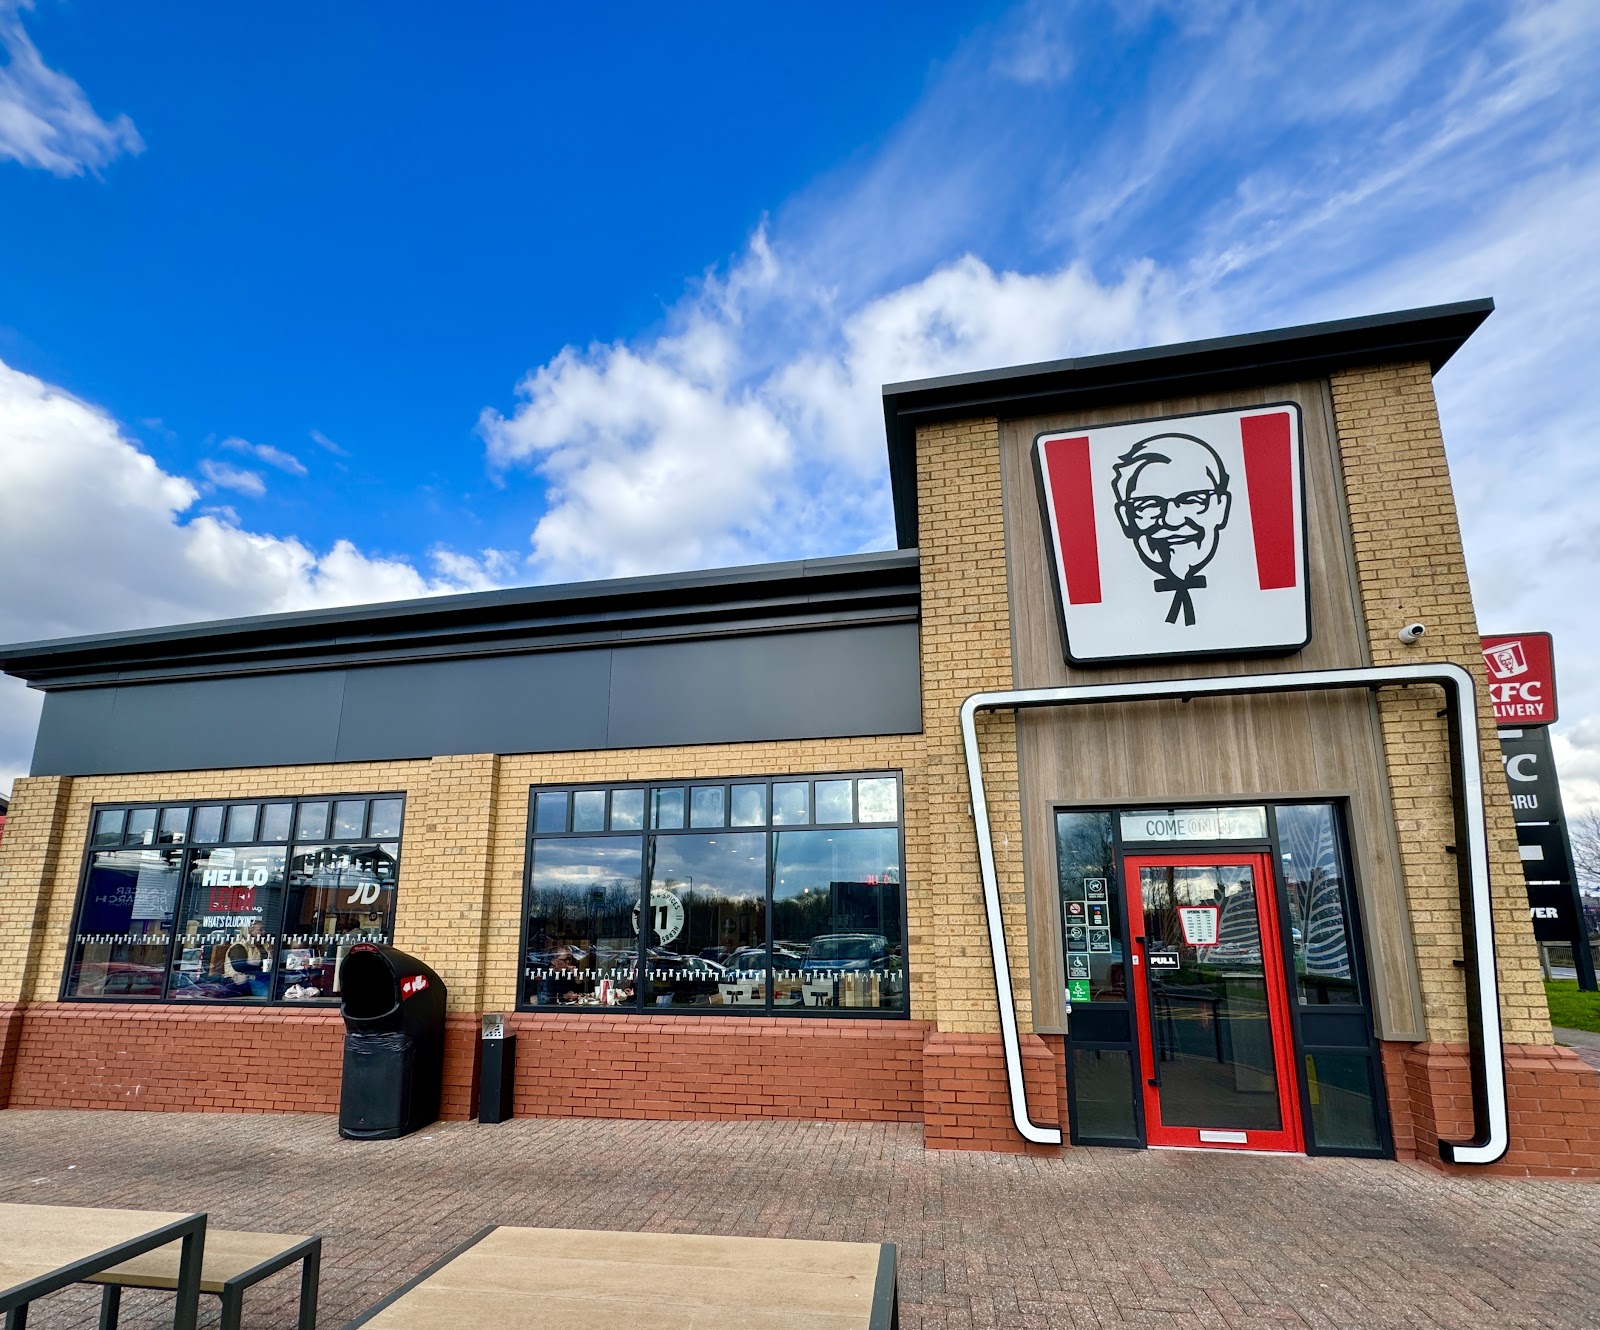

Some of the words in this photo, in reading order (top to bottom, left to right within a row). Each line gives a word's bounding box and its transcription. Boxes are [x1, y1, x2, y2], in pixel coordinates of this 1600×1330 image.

[1489, 681, 1542, 703] KFC
[1502, 754, 1538, 782] C
[1146, 820, 1186, 836] COME
[1188, 818, 1210, 835] ON
[202, 868, 268, 889] HELLO
[347, 882, 381, 905] JD
[662, 893, 681, 911] SPICES
[202, 916, 225, 928] WHAT'S
[661, 925, 680, 943] HERBS
[1151, 957, 1176, 965] PULL
